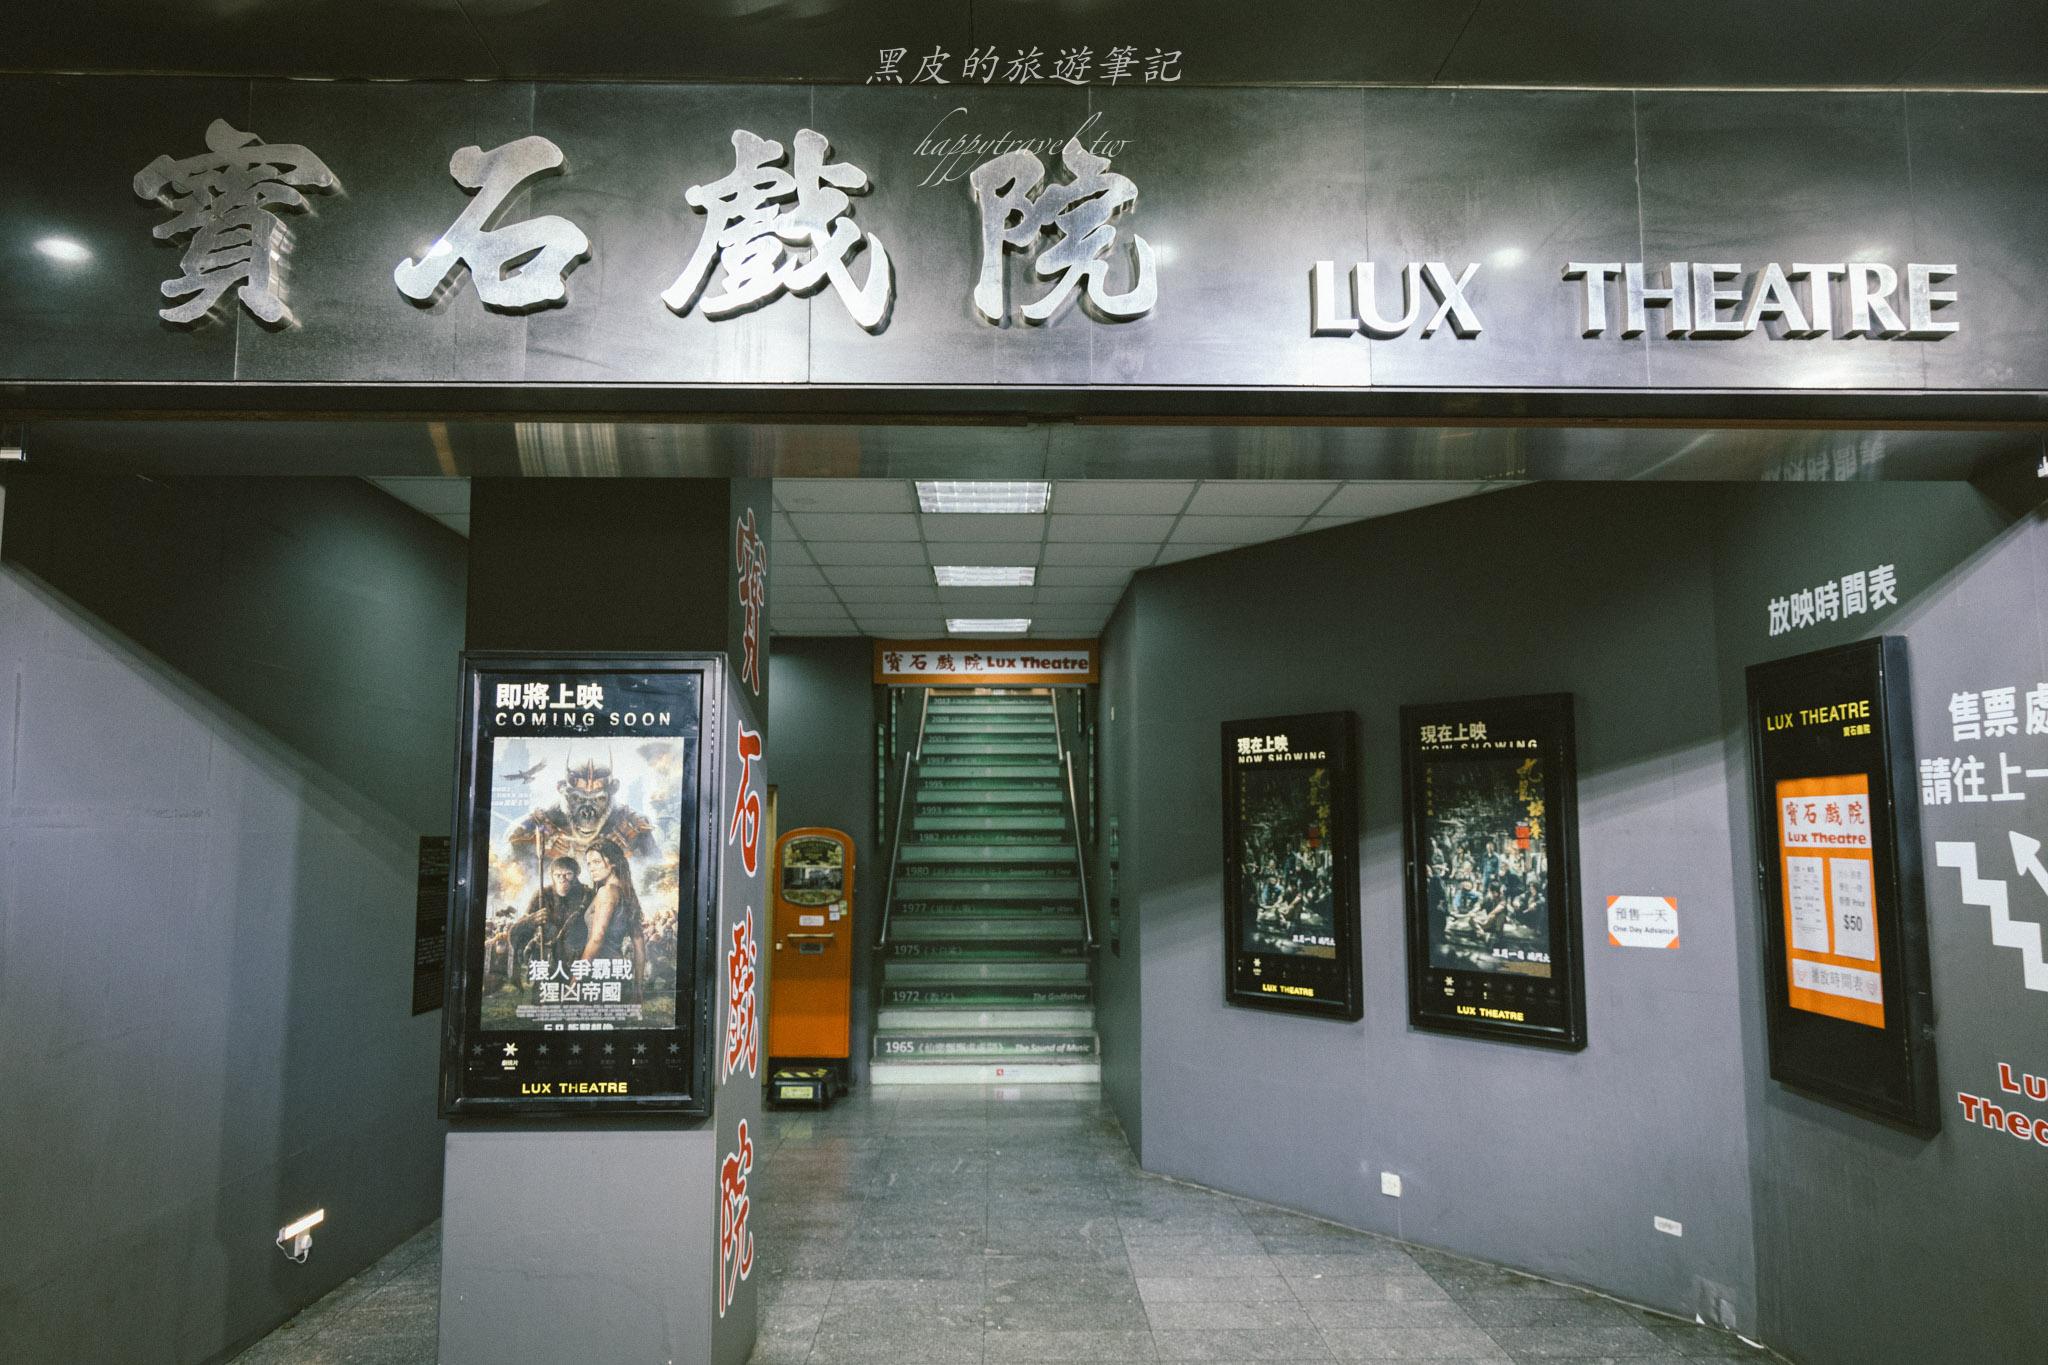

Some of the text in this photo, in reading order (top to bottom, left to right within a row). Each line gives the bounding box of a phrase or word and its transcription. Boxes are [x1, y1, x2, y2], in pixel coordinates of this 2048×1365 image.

[1310, 261, 1959, 340] LUX THEATRE
[1768, 563, 1898, 637] 放映時間表
[987, 656, 1016, 668] Lux
[1020, 656, 1089, 669] Theatre
[496, 683, 604, 710] 即將上映
[496, 712, 671, 726] COMING SOON
[1767, 700, 1871, 732] LUX THEATRE
[1421, 721, 1487, 743] 現在上映
[1237, 734, 1289, 755] 現在上映
[1238, 751, 1326, 763] NOW SHOWING
[1788, 832, 1867, 844] Lux Theatre
[902, 904, 927, 914] 1977
[1612, 925, 1627, 933] One
[1629, 926, 1642, 934] Day
[1843, 914, 1863, 932] $50
[895, 945, 920, 955] 1975
[528, 958, 633, 981] 猿人爭霸戰
[539, 981, 622, 1003] 猩凶帝國
[892, 991, 919, 1002] 1972
[1262, 983, 1314, 997] LUX THEATRE
[1457, 1005, 1524, 1022] LUX THEATRE
[885, 1041, 914, 1053] 1965
[1031, 1043, 1056, 1052] Sound
[521, 1082, 628, 1094] LUX THEATRE
